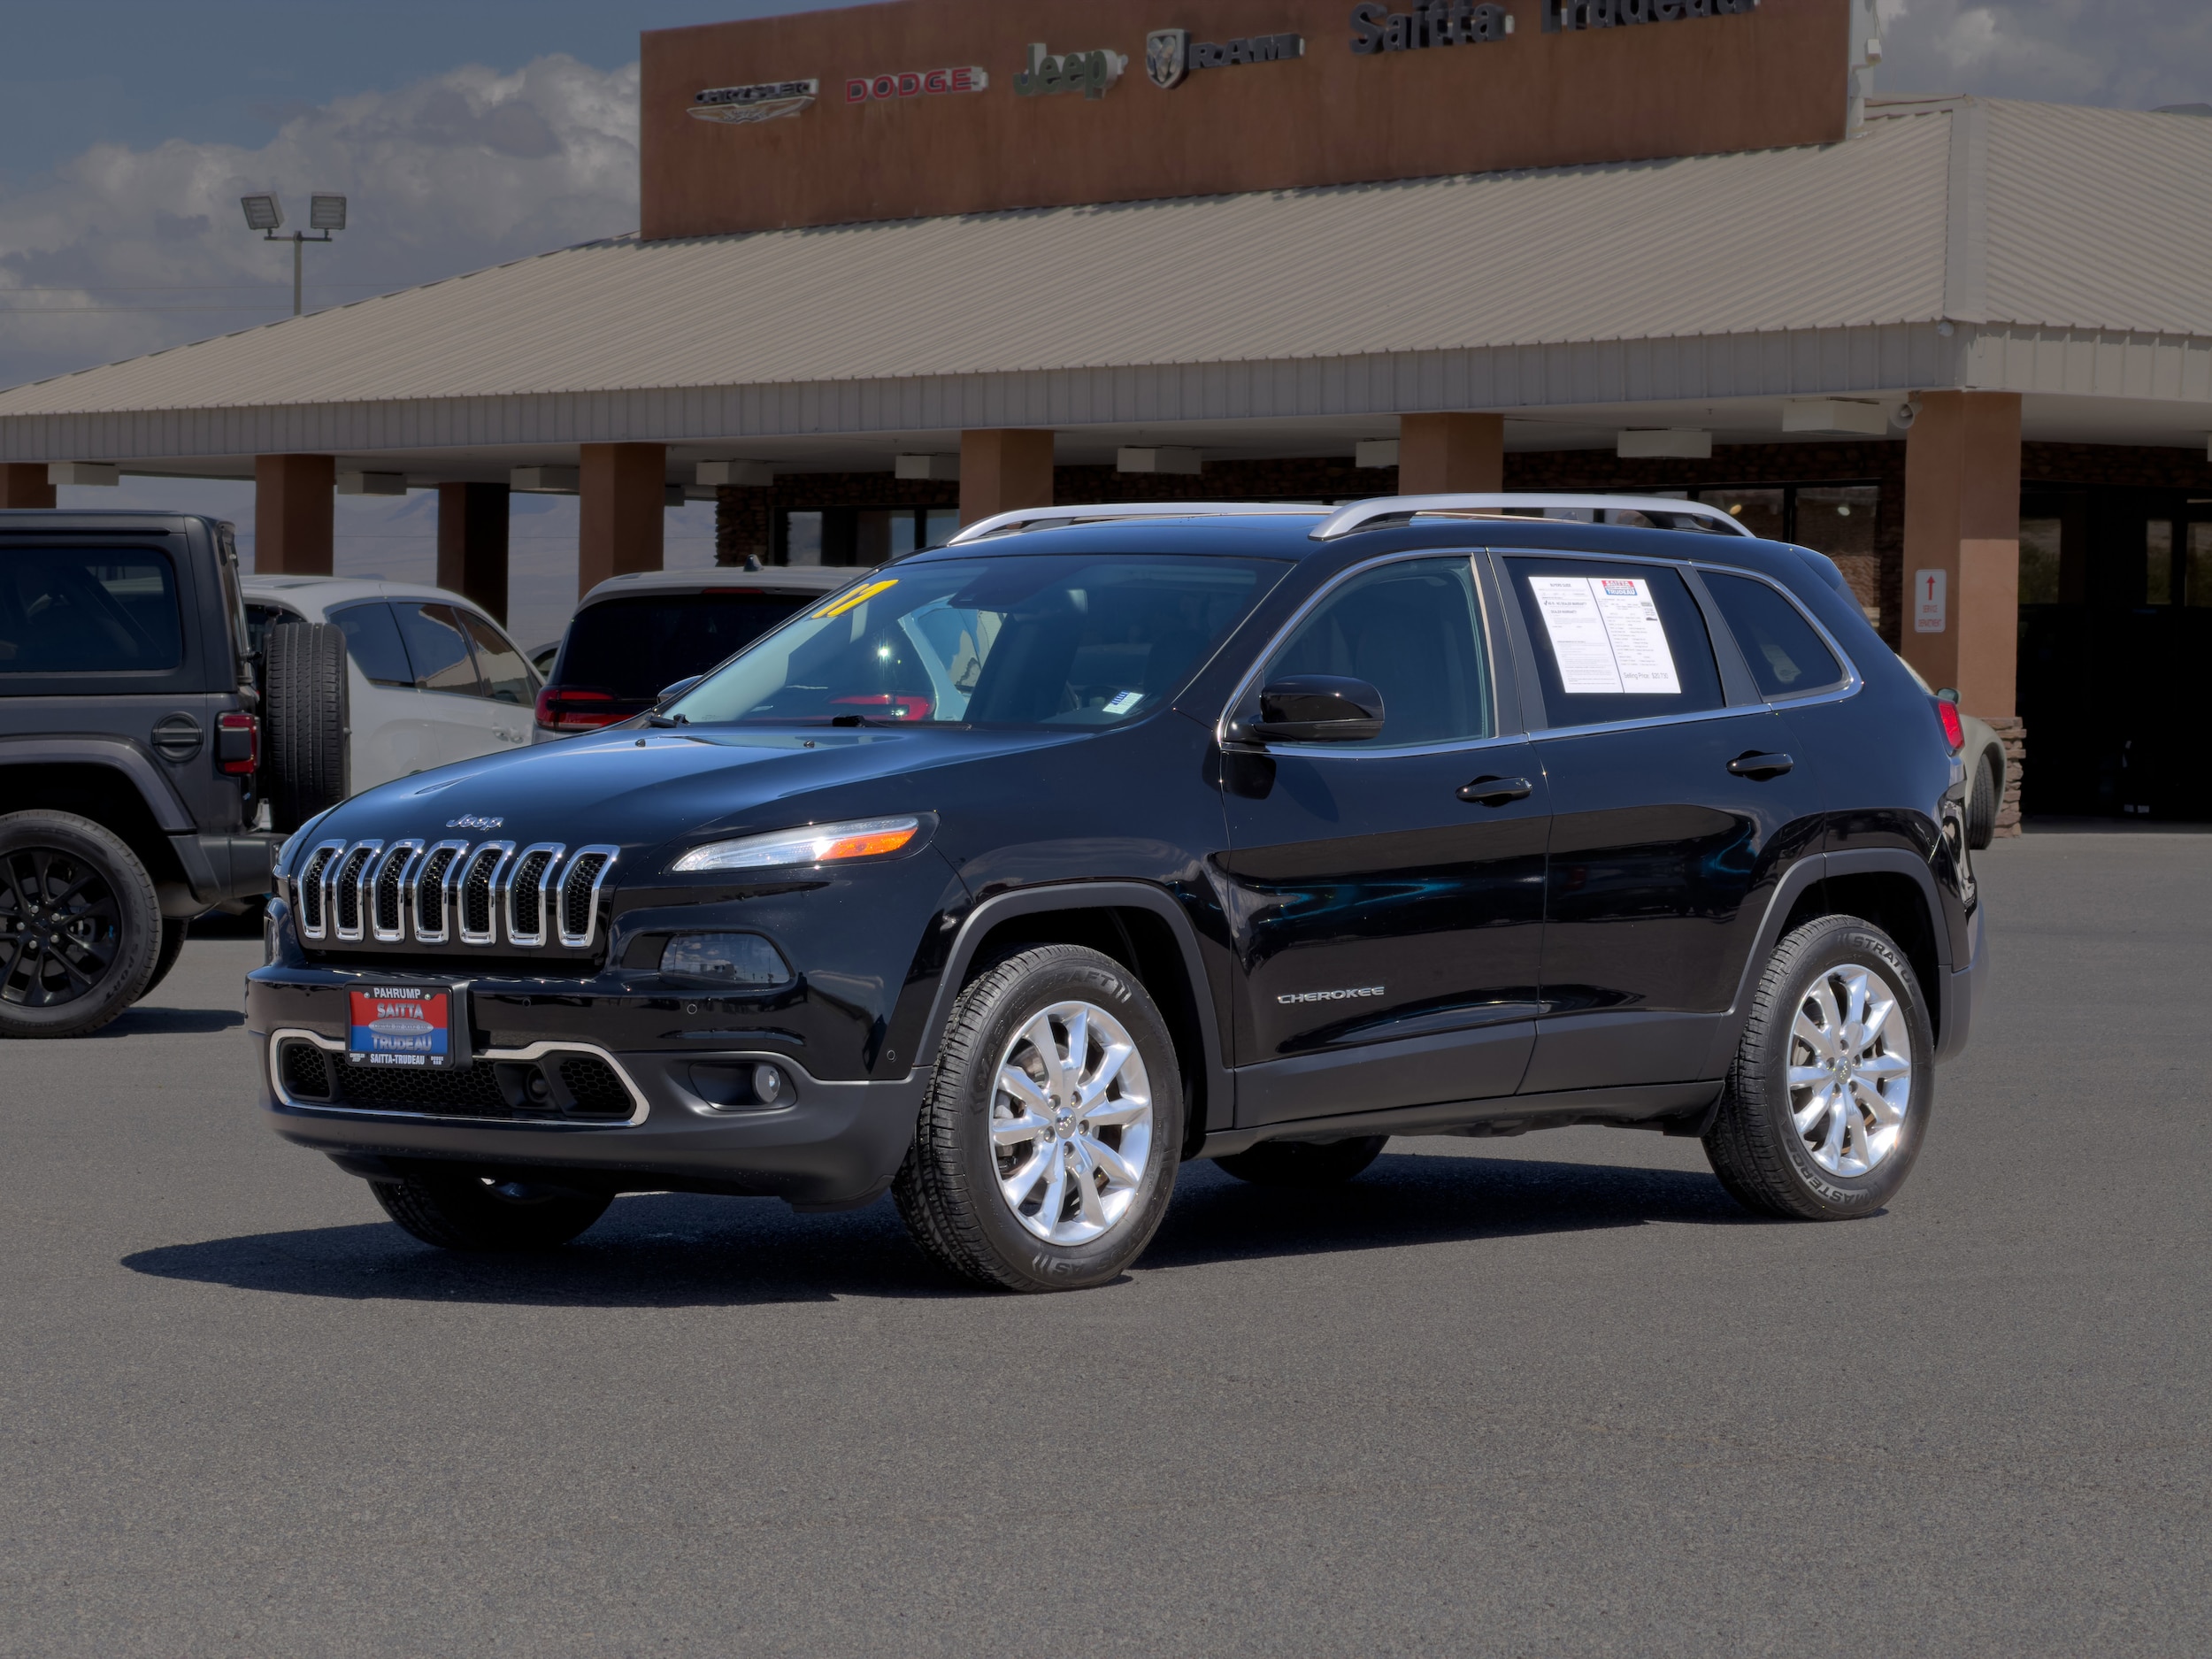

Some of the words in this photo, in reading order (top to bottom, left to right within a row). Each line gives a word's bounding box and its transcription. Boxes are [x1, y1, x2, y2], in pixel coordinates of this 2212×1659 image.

[1350, 0, 1504, 54] Saitta
[1189, 33, 1295, 70] RAM
[1013, 43, 1111, 100] Jeep
[694, 80, 812, 104] CHRYSLER
[845, 66, 975, 104] DODGE
[446, 814, 503, 832] Jeep
[373, 987, 421, 999] PAHRUMP
[1278, 987, 1385, 1004] CHEROKEE
[377, 1003, 425, 1020] SAITTA
[372, 1034, 433, 1052] TRUDEAU
[370, 1054, 425, 1065] SAITTA-TRUDEAU
